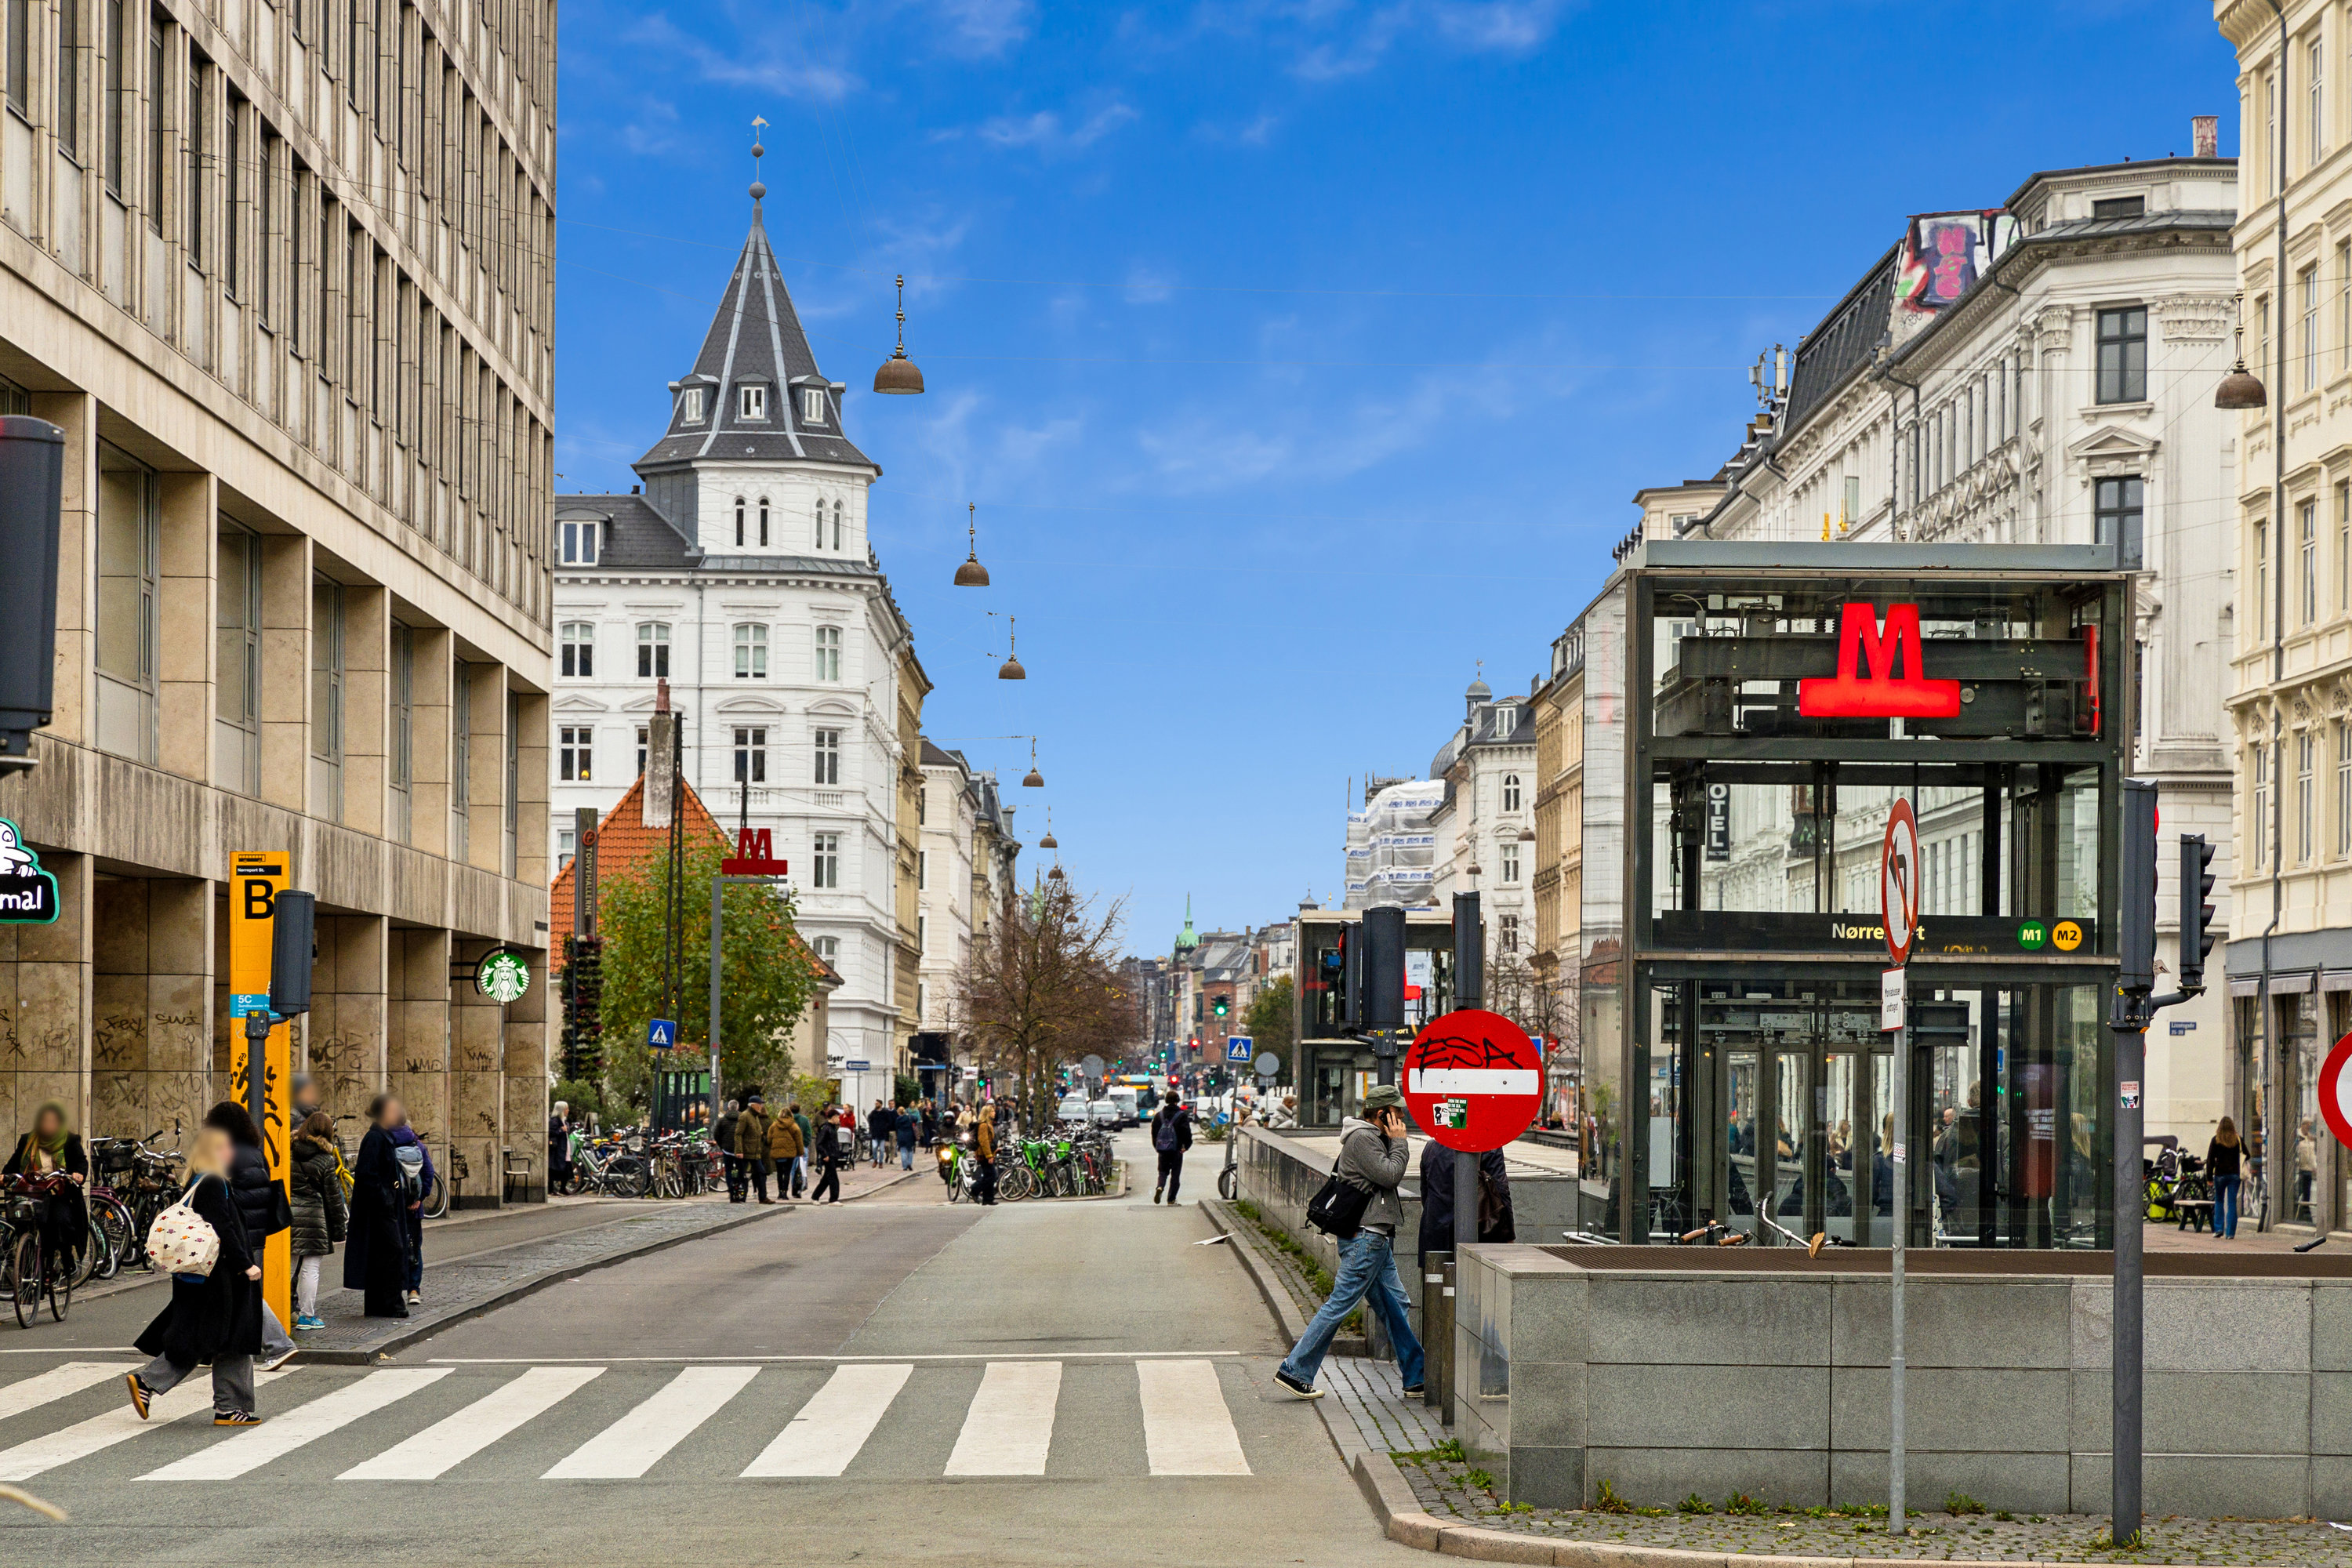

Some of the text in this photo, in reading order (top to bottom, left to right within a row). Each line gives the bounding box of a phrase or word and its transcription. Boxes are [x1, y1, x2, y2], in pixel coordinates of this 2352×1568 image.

[1709, 784, 1727, 847] OTEL
[245, 879, 274, 920] B
[1832, 923, 1926, 940] Nørret
[2022, 929, 2042, 942] M1
[2056, 930, 2078, 941] M2
[238, 994, 252, 1004] 5C
